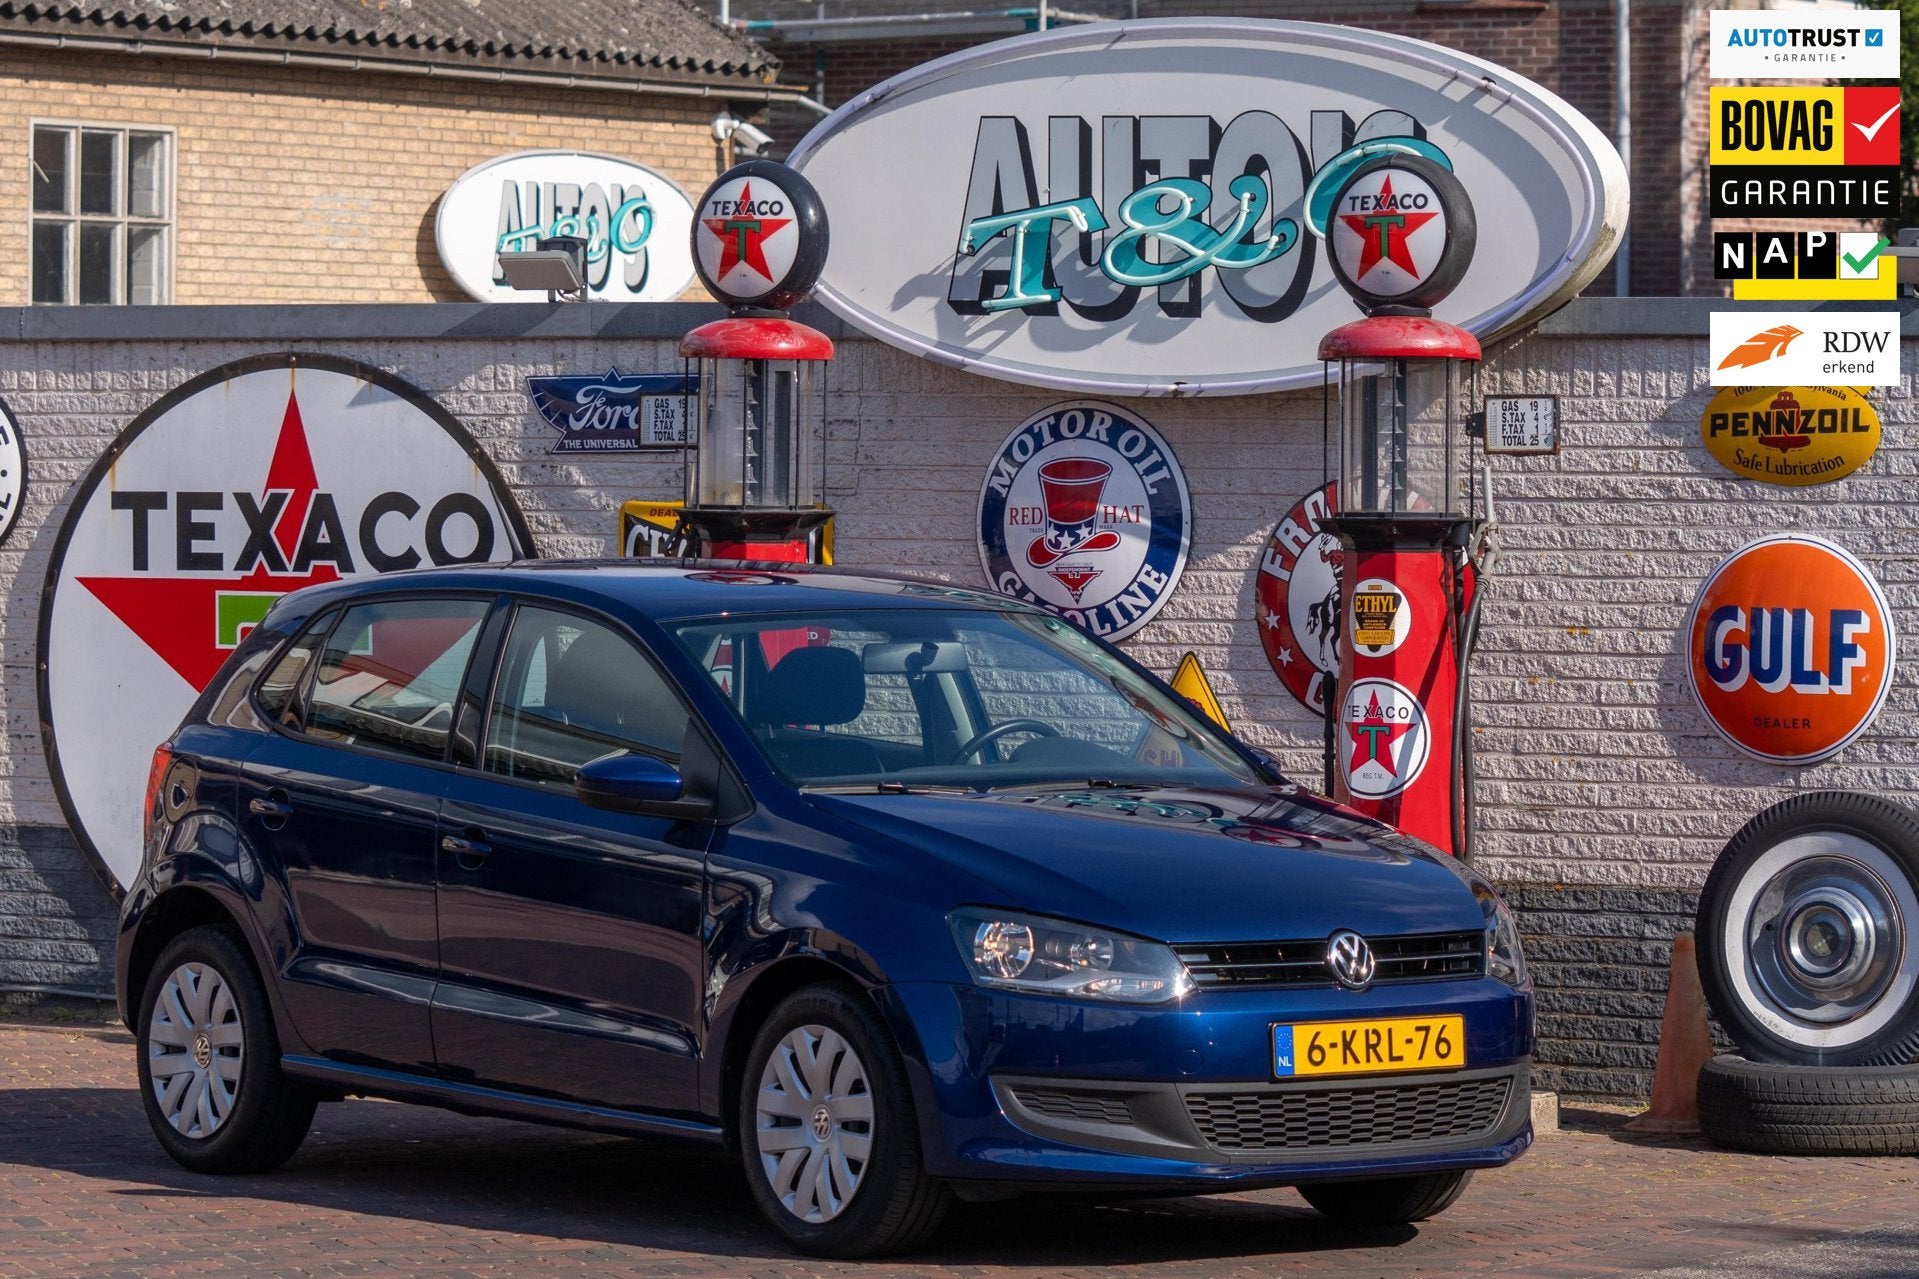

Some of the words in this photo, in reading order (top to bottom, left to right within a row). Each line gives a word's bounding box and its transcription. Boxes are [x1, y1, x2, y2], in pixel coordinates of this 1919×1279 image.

[712, 200, 784, 217] TEXACO
[1349, 193, 1429, 212] TEXACO
[654, 398, 670, 409] GAS
[1501, 400, 1519, 412] GAS
[1529, 400, 1539, 412] 19
[654, 409, 676, 420] S.TAX
[1501, 412, 1526, 424] S.TAX
[1534, 412, 1539, 424] 4
[1501, 423, 1525, 435] F.TAX
[1710, 407, 1871, 438] PENNZOIL
[654, 431, 676, 441] TOTAL
[1501, 435, 1527, 447] TOTAL
[1529, 435, 1540, 447] 25
[563, 440, 581, 449] THE
[583, 439, 639, 449] UNIVERSAL
[989, 410, 1113, 498] MOTOR
[1117, 429, 1172, 495] OIL
[1733, 448, 1763, 472] Safe
[1766, 454, 1845, 476] Lubrication
[1009, 507, 1043, 526] RED
[1103, 505, 1144, 524] HAT
[111, 490, 495, 574] TEXACO
[1355, 595, 1397, 613] ETHYL
[1703, 605, 1871, 695] GULF
[1753, 717, 1812, 730] DEALER
[1307, 1024, 1452, 1067] 6-KRL-76
[1278, 1056, 1292, 1068] NL
